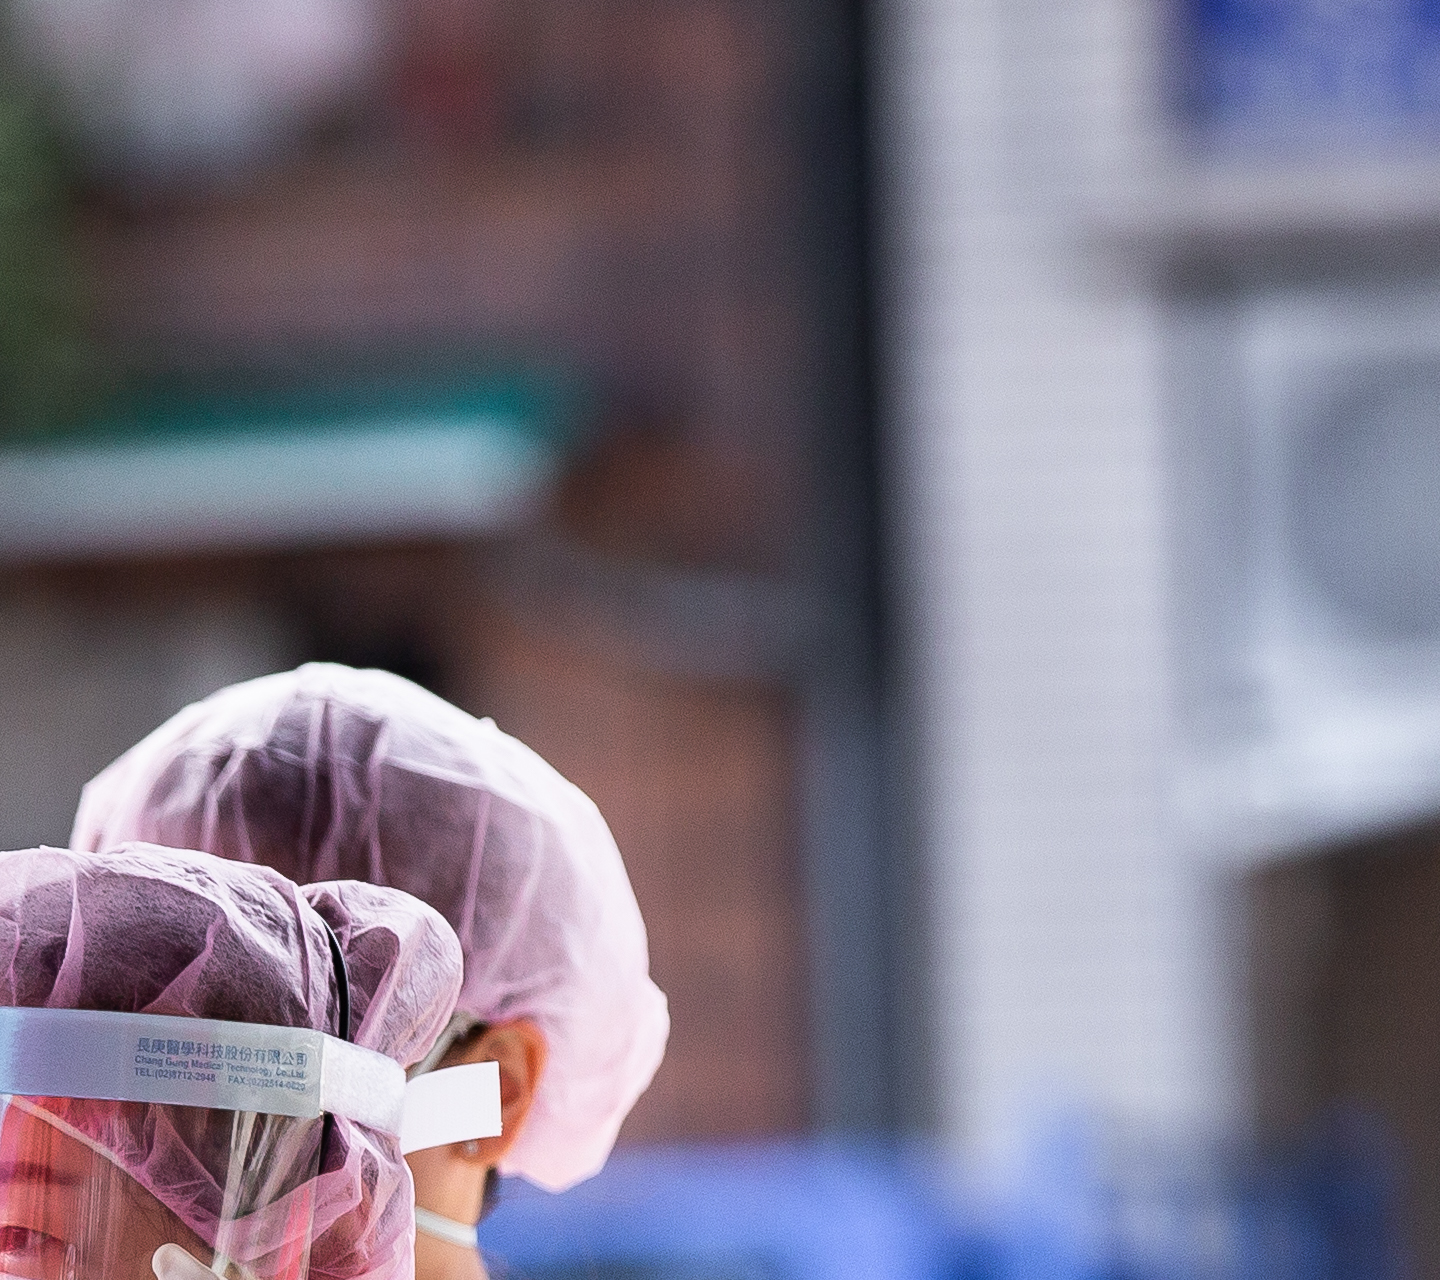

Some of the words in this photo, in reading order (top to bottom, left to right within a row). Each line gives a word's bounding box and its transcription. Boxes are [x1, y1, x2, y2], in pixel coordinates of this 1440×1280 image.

[134, 1054, 163, 1067] Chang
[165, 1056, 189, 1069] Gung
[191, 1058, 224, 1070] Medical
[137, 1037, 308, 1067] 長庚醫學科技股份有限公司
